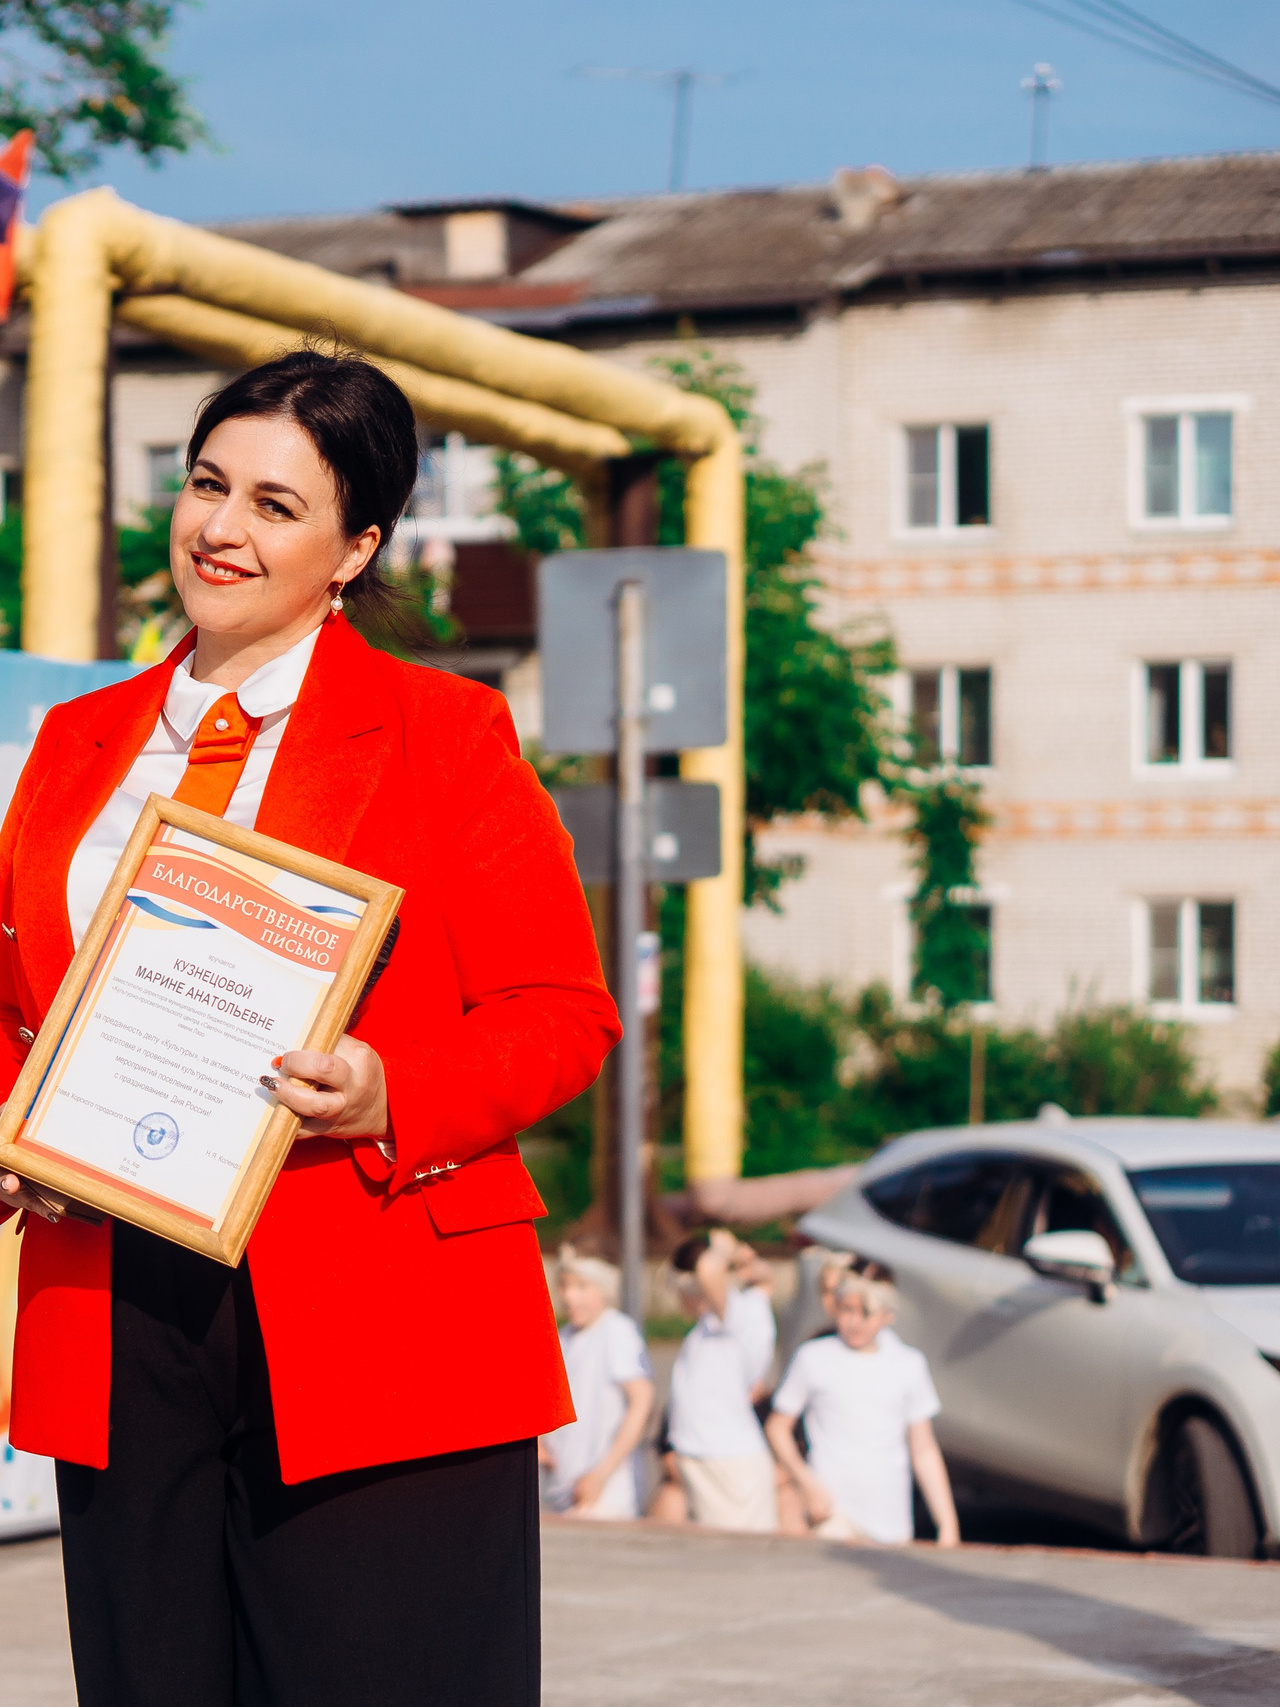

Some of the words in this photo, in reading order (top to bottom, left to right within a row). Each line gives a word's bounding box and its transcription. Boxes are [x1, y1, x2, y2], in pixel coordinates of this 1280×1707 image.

[150, 861, 340, 950] БЛАГОДАРСТВЕННОЕ
[207, 954, 236, 970] вручается
[259, 927, 331, 966] ПИСЬМО
[134, 964, 186, 994] МАРИНЕ
[184, 985, 275, 1031] АНАТОЛЬЕВНЕ
[172, 956, 254, 1000] КУЗНЕЦОВОЙ
[93, 1010, 102, 1019] за
[101, 1014, 143, 1037] преданность
[141, 1031, 160, 1045] делу
[200, 1055, 210, 1064] за
[208, 1059, 240, 1077] активное
[99, 1030, 136, 1051] подготовке
[141, 1048, 181, 1070] проведении
[179, 1064, 219, 1086] культурных
[218, 1080, 252, 1099] массовых
[113, 1054, 158, 1078] мероприятий
[157, 1072, 193, 1092] поселения
[203, 1091, 224, 1105] связи
[117, 1073, 169, 1100] празднованием
[169, 1094, 185, 1107] Дня
[184, 1099, 212, 1118] России!
